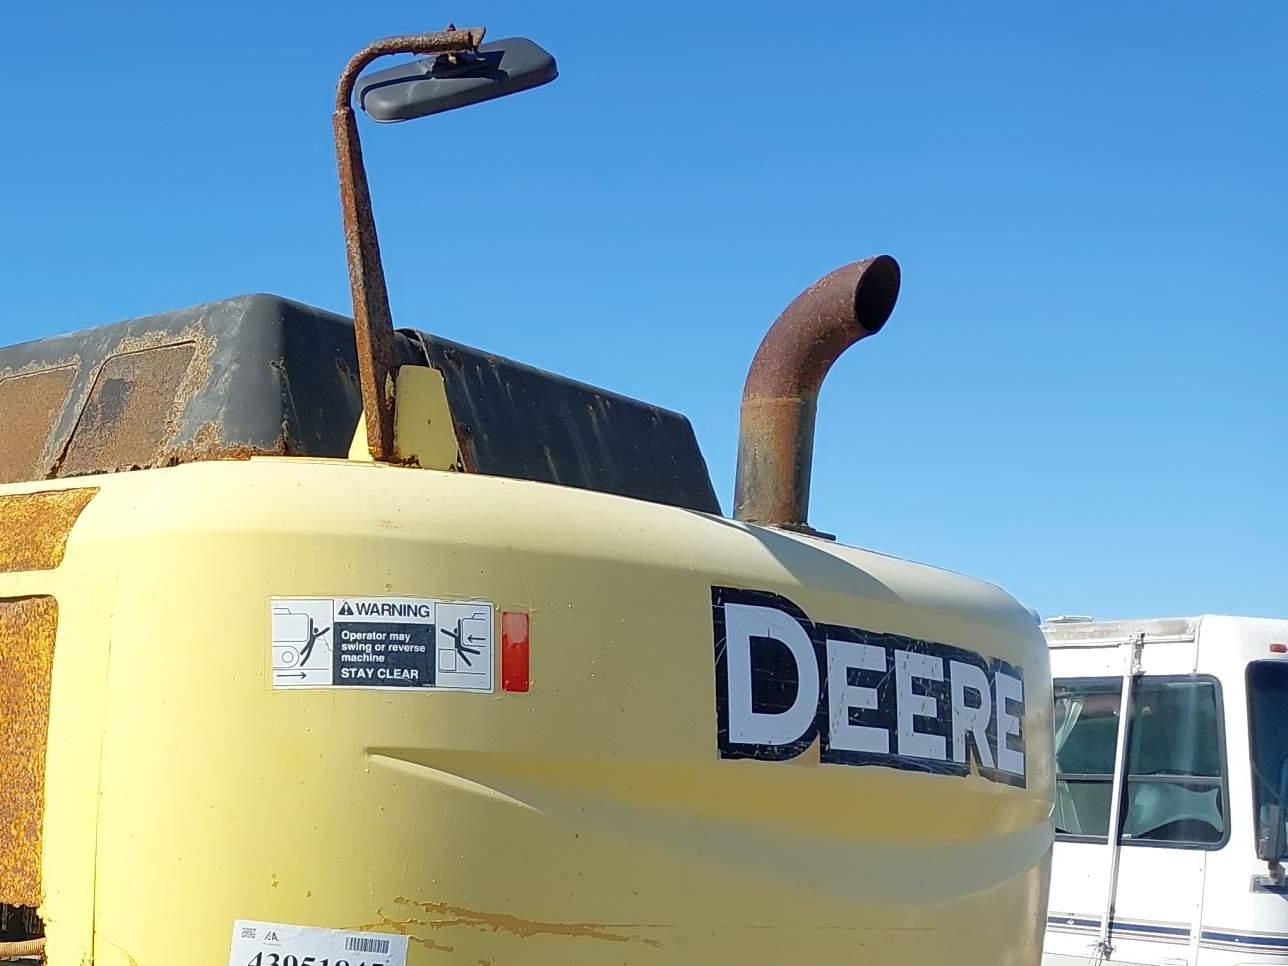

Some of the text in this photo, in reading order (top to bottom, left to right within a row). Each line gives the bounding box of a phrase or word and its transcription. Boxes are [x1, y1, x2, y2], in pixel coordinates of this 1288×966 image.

[355, 602, 430, 618] WARNING
[341, 630, 411, 644] Operator may
[341, 642, 426, 654] swing or reverse
[341, 653, 385, 663] machine
[340, 668, 419, 680] STAY CLEAR
[723, 602, 1025, 777] DEERE
